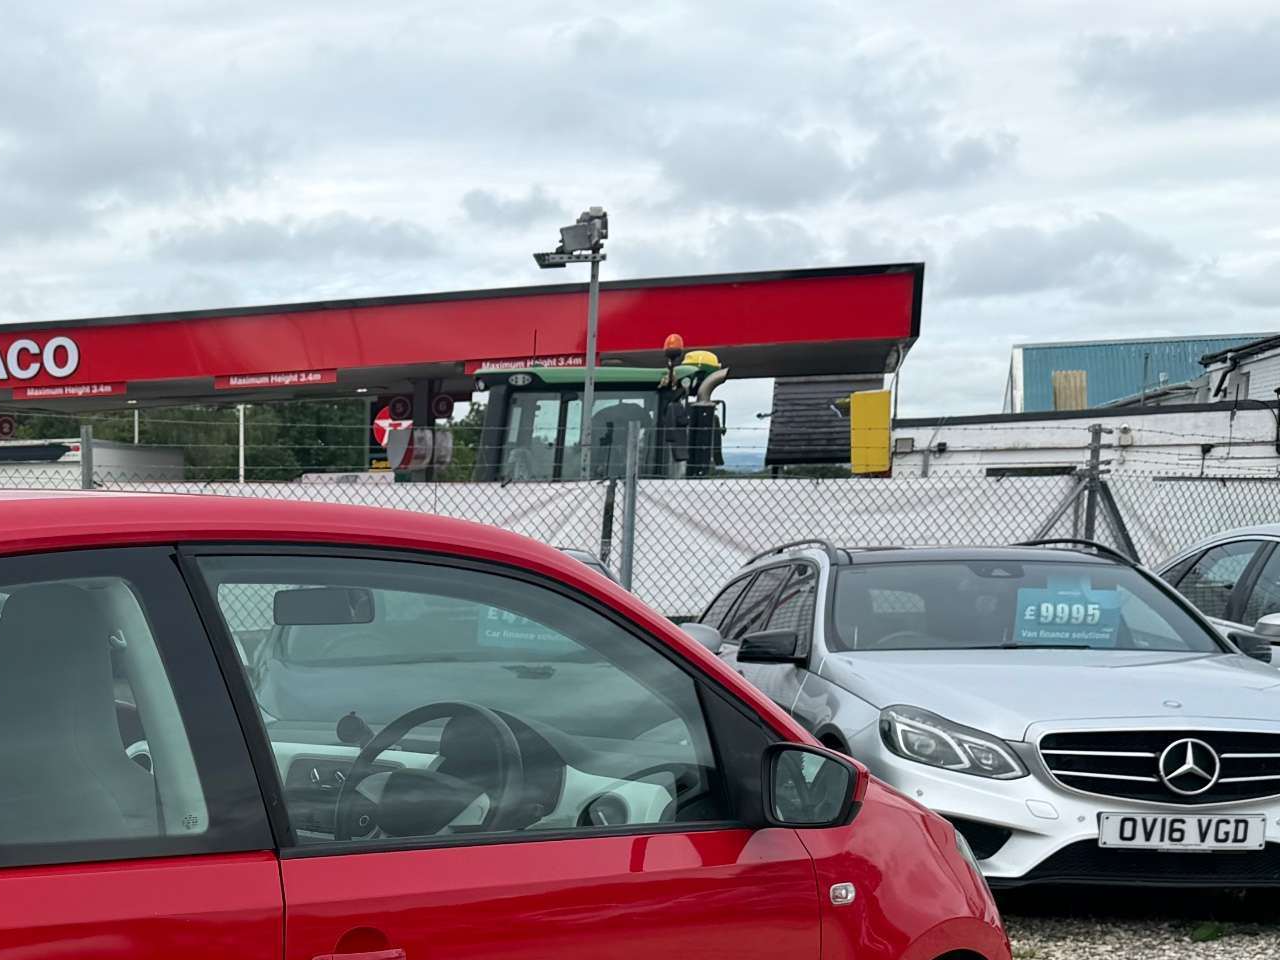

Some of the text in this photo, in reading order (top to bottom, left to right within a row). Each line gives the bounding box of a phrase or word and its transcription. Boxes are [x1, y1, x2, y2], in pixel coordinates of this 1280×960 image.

[481, 360, 525, 369] Maximum
[558, 356, 583, 366] 3.4m
[229, 375, 270, 385] Maximum
[270, 373, 298, 384] Height
[26, 386, 64, 396] Maximum
[64, 385, 91, 396] Height
[1021, 629, 1037, 638] Van
[1119, 817, 1249, 844] OV16 VGD
